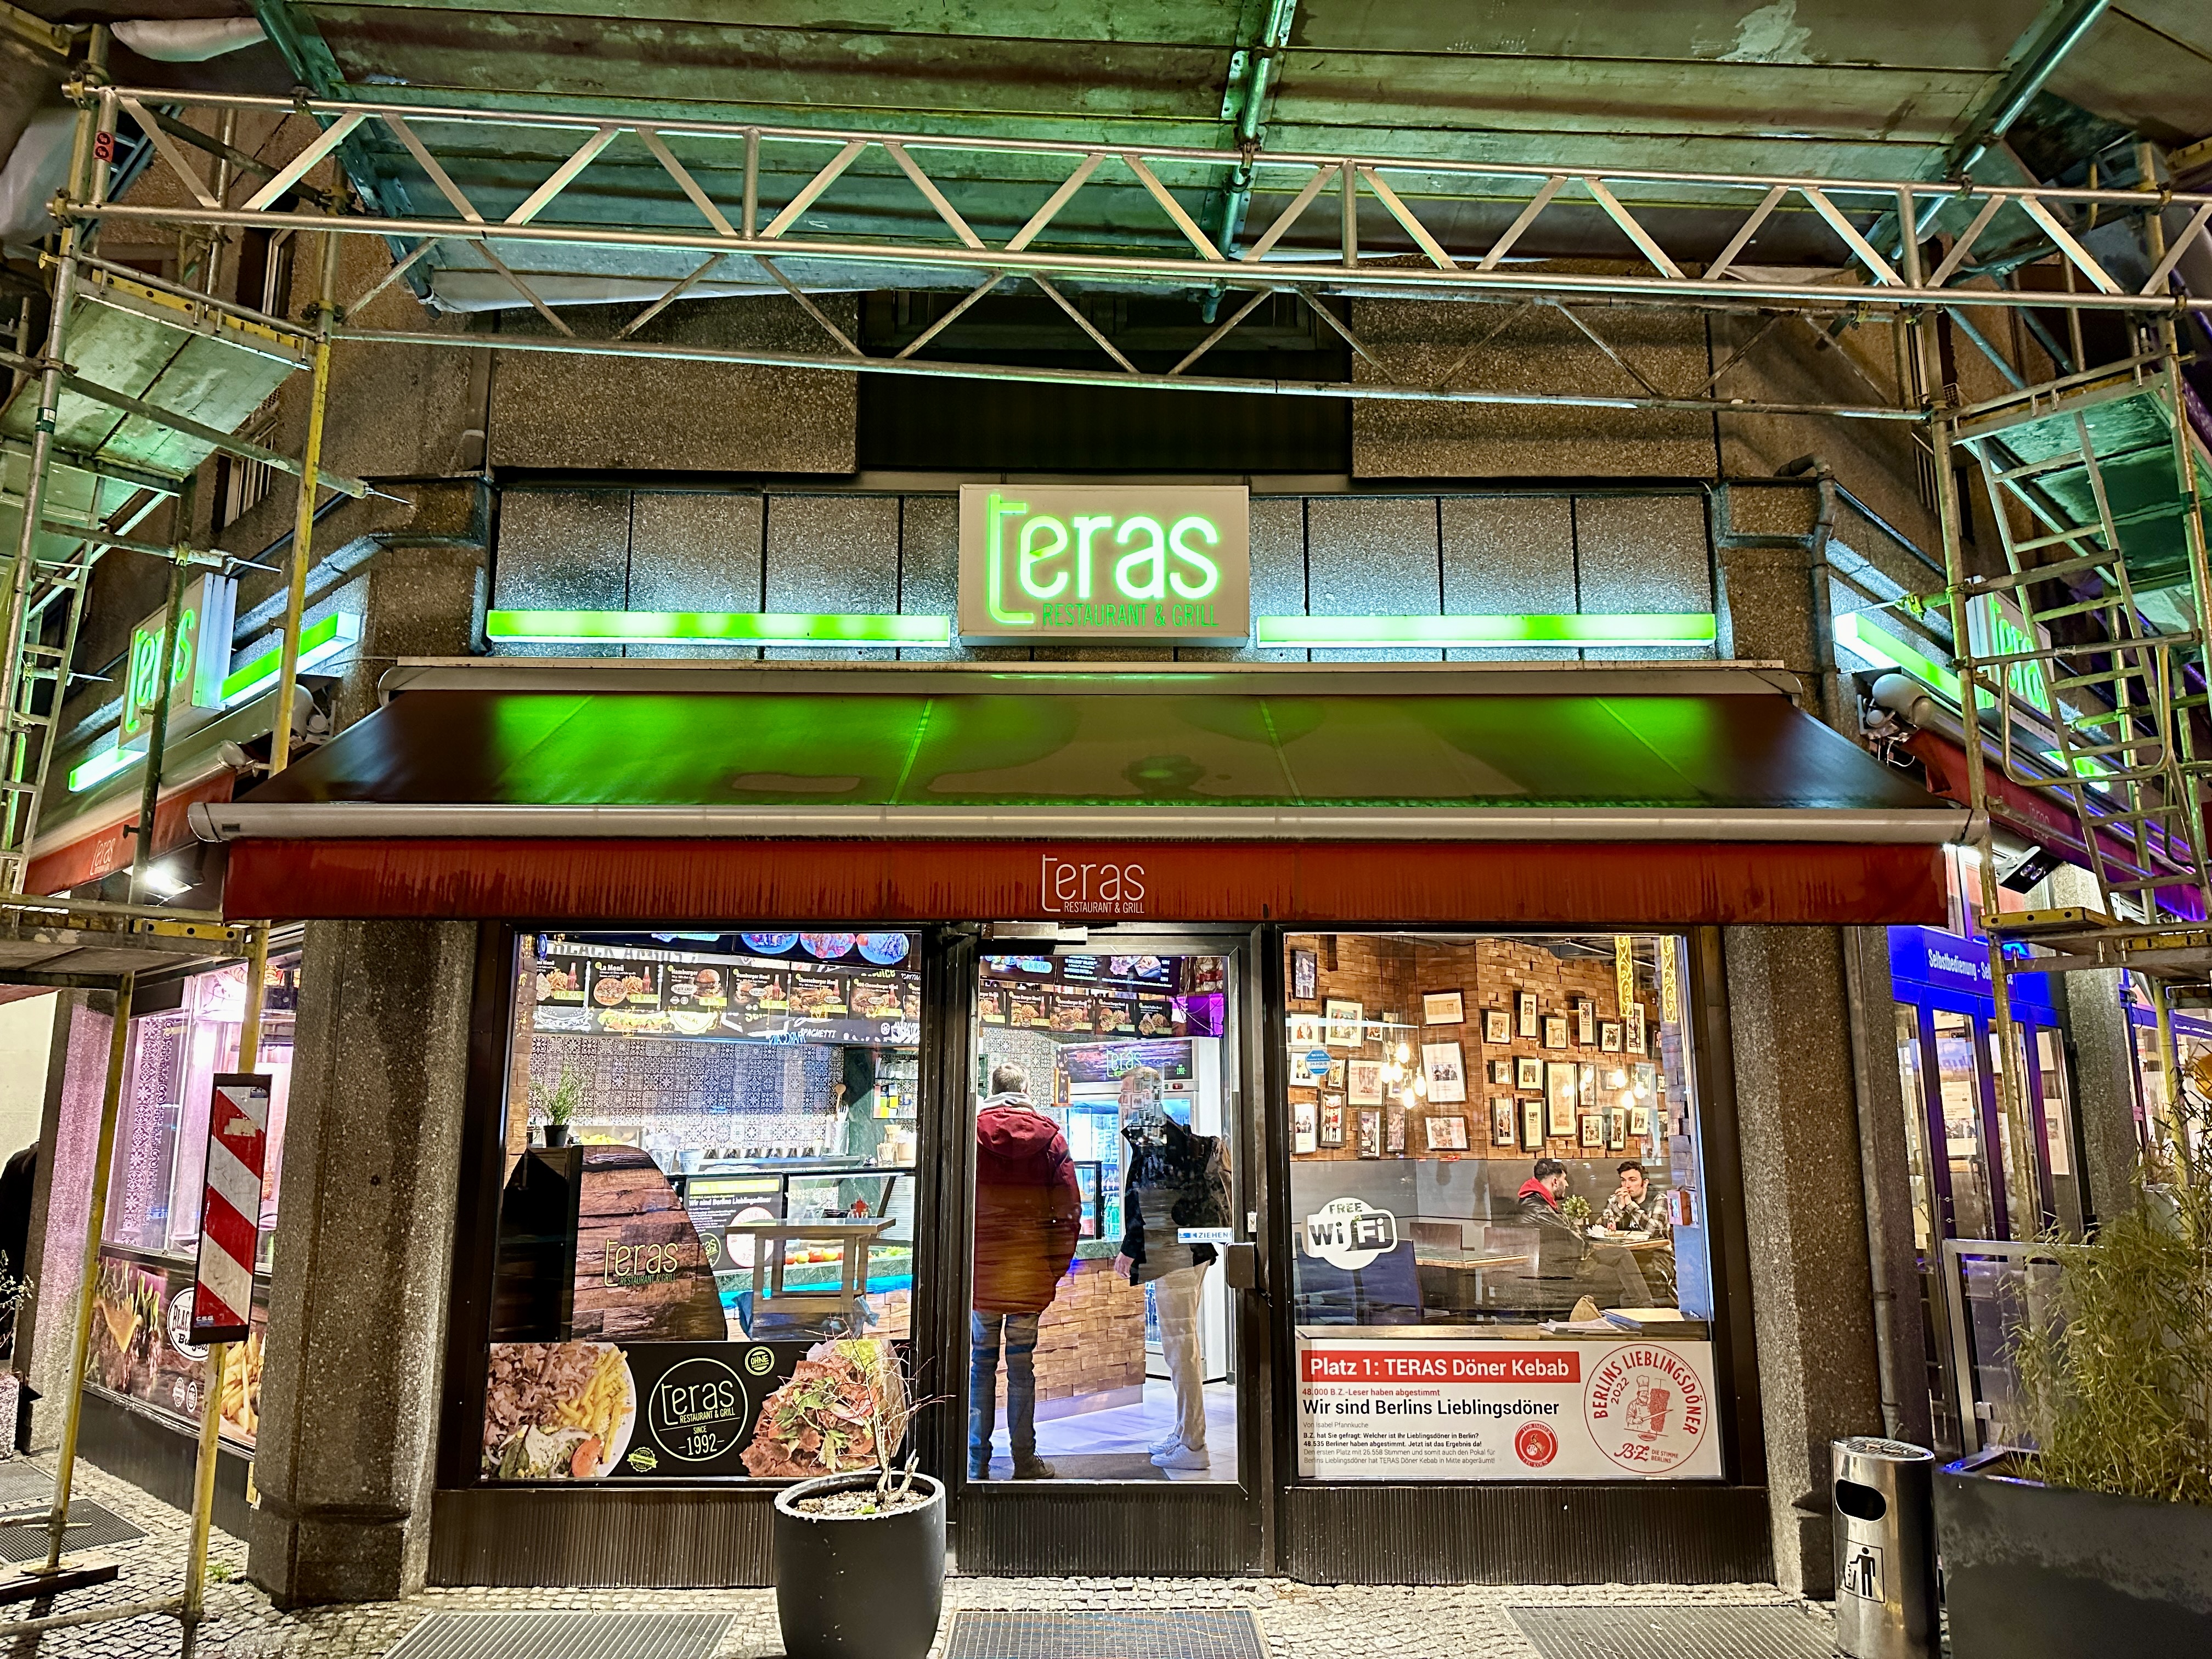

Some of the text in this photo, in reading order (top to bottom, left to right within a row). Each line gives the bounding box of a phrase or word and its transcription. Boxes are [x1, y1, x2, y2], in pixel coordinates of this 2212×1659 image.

[989, 493, 1218, 624] teras
[1043, 603, 1219, 627] RESTAURANT & GRILL
[125, 608, 196, 733] ters
[1042, 854, 1144, 912] teras
[1064, 901, 1145, 913] RESTAURANT & GRILL
[1928, 949, 1977, 981] Selbstbedienung
[681, 1014, 698, 1024] HALAL
[800, 1028, 837, 1039] SPAGHETTI
[1329, 1203, 1362, 1214] FREE
[604, 1239, 679, 1286] teras
[620, 1274, 654, 1286] RESTAURANT
[661, 1273, 676, 1283] GRILL
[751, 1355, 769, 1364] OHNE
[1311, 1357, 1569, 1376] Platz 1: TERAS Döner Kebab
[1395, 1389, 1440, 1397] abgestimmt
[1593, 1361, 1622, 1419] BERLINS
[1622, 1351, 1703, 1435] LIEBLINGSDÖNER
[1611, 1377, 1629, 1404] 2022
[662, 1380, 734, 1425] teras
[1303, 1399, 1559, 1418] Wir sind Berlins Lieblingsdöner
[680, 1410, 713, 1424] RESTAURANT
[720, 1407, 735, 1417] GRILL
[693, 1426, 707, 1434] SINCE
[1651, 1455, 1671, 1463] BERLINS
[1661, 1451, 1679, 1459] STIMME
